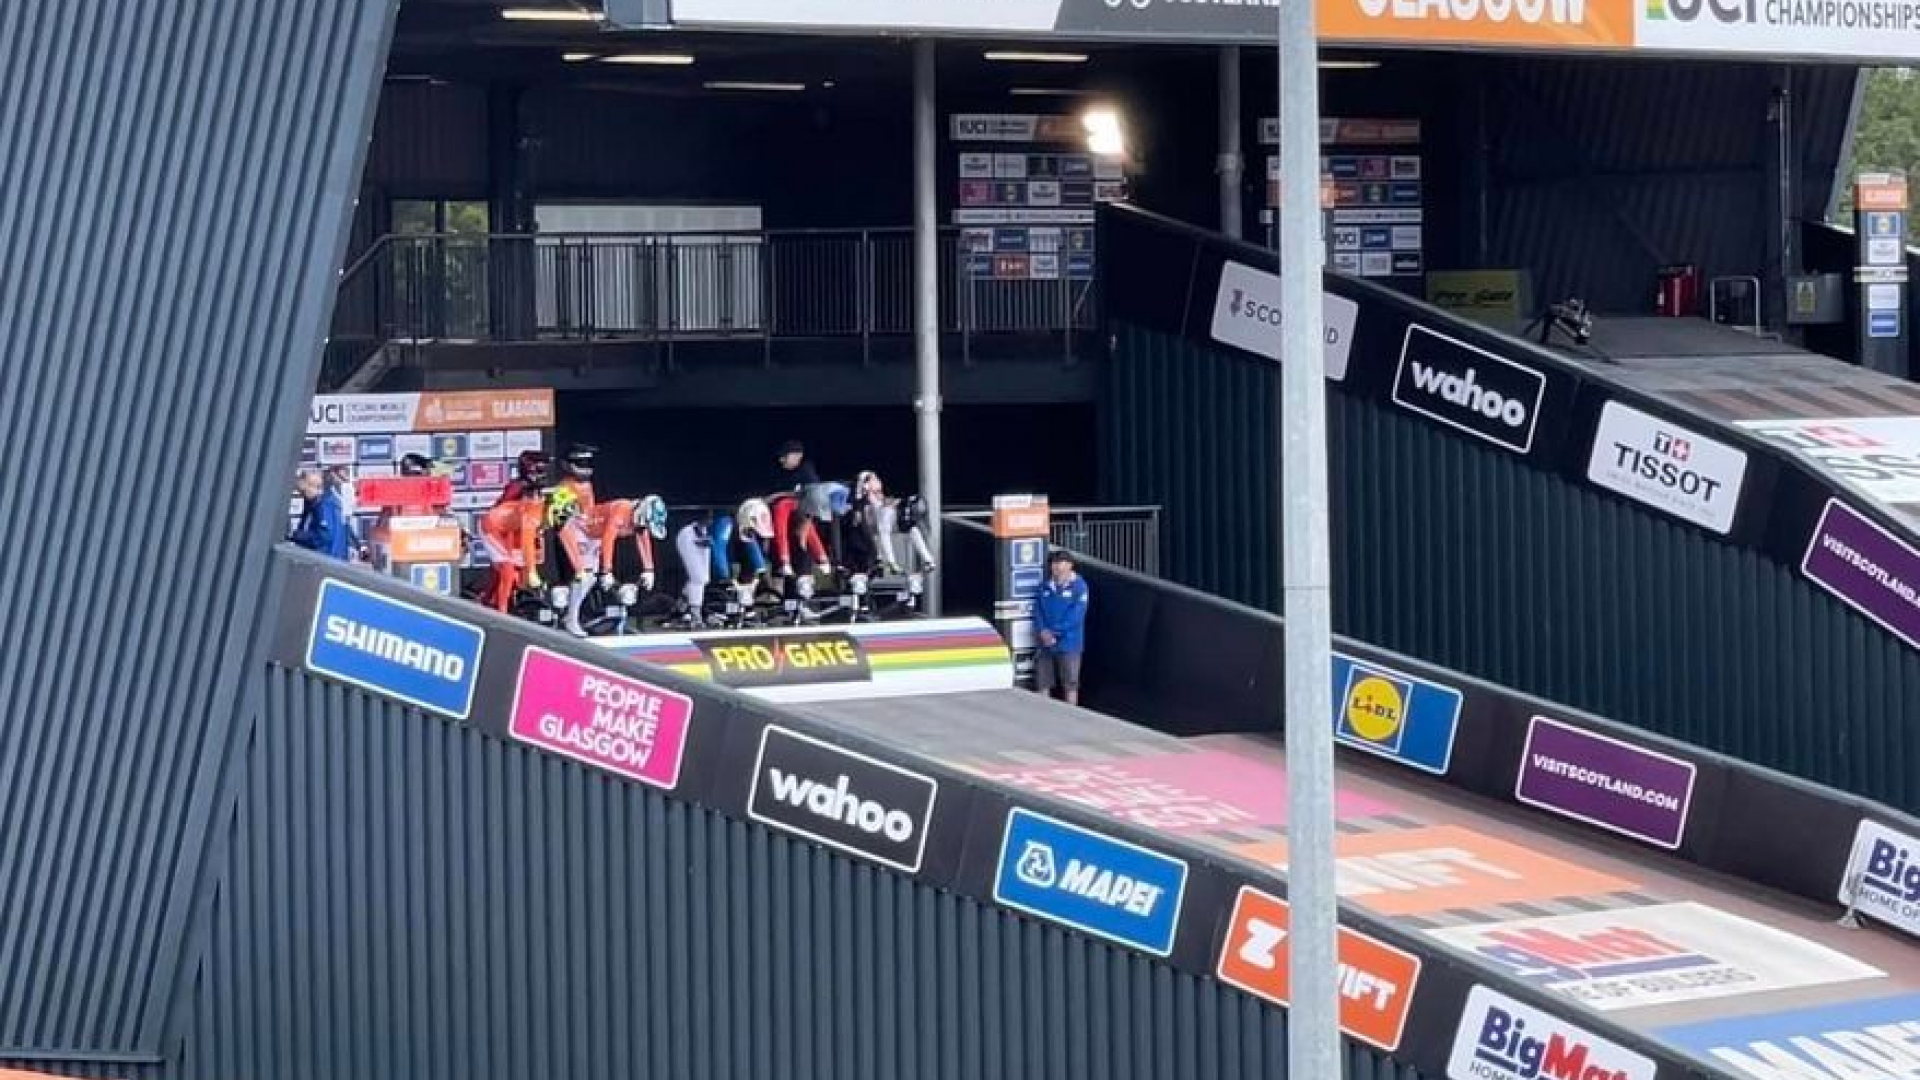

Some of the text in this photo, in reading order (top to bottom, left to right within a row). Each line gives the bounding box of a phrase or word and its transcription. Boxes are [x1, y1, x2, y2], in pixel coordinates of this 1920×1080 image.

[1411, 361, 1525, 427] wahoo
[1613, 442, 1721, 502] TISSOT
[326, 615, 464, 682] SHIMANO
[712, 640, 858, 671] PRO GATE
[581, 674, 662, 721] PEOPLE
[594, 704, 657, 746] MAKE
[540, 713, 651, 767] GLASGOW
[770, 768, 913, 842] wahoo
[1533, 753, 1678, 811] VISITSCOTLAND.COM
[1059, 858, 1164, 917] MAPEI
[1239, 918, 1396, 1011] ZIFT
